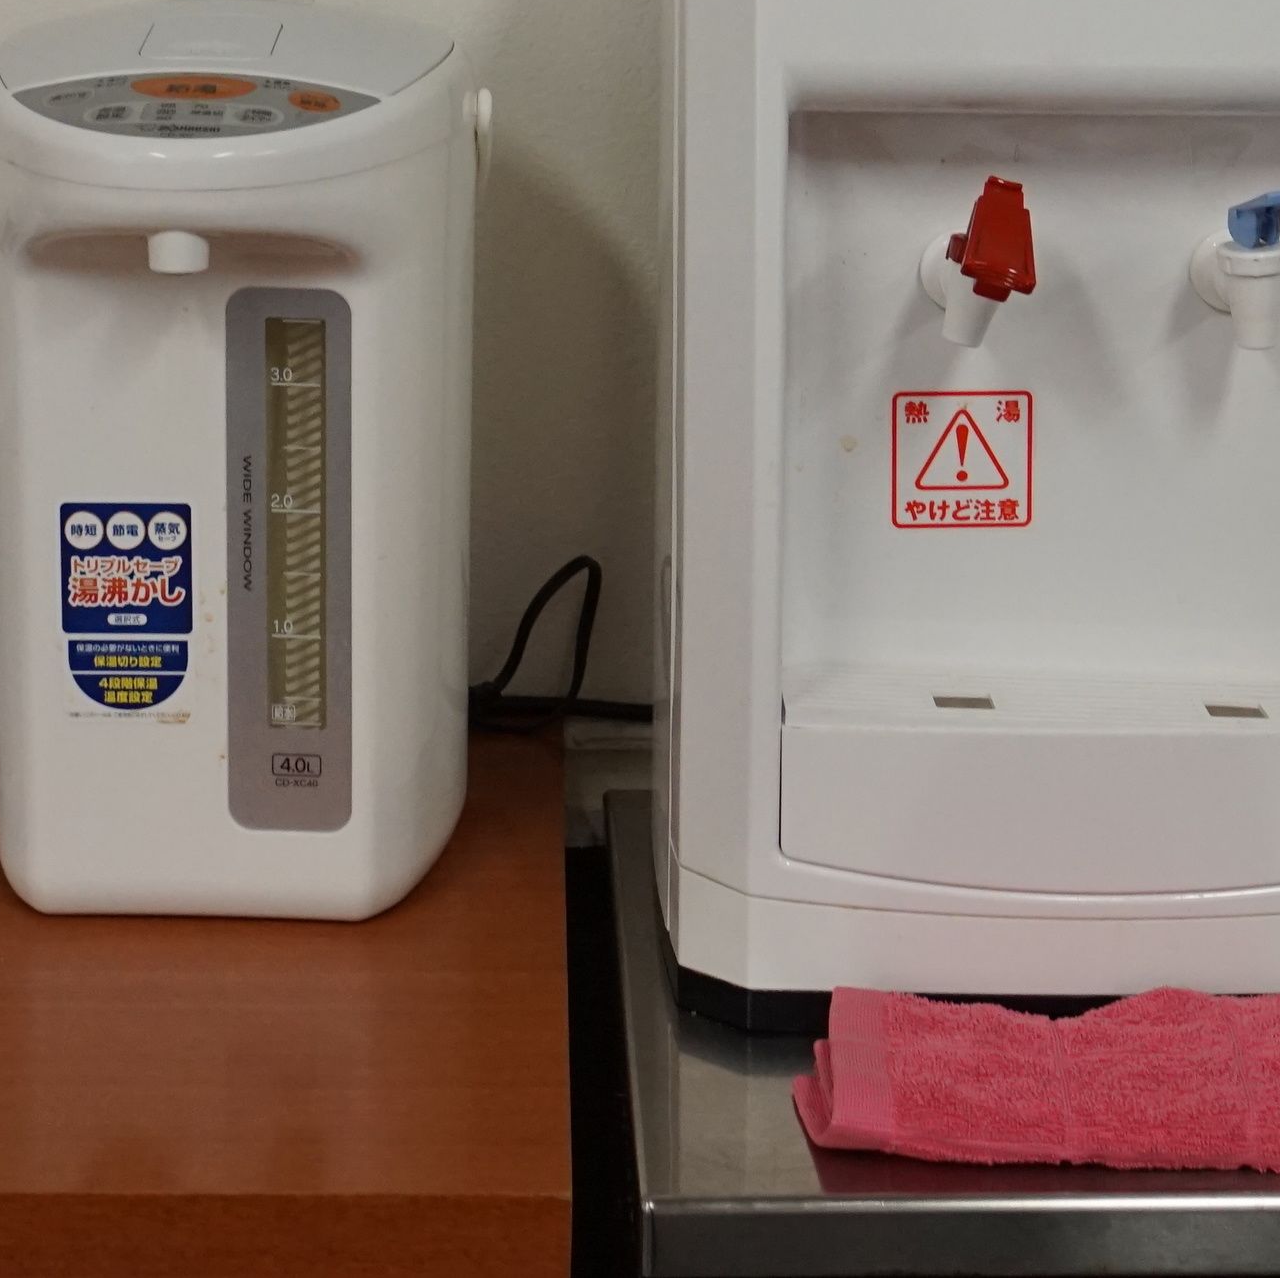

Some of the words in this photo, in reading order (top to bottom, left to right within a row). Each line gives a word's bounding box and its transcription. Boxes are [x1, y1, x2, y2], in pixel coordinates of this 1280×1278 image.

[270, 367, 293, 382] 3.0
[905, 401, 929, 423] 熱
[996, 400, 1020, 422] 湯
[242, 455, 253, 503] WIDE
[270, 494, 293, 508] 2.0
[905, 498, 1019, 521] やけど注意
[70, 524, 97, 537] 時短
[112, 524, 139, 537] 節電
[154, 522, 180, 535] 蒸気
[242, 508, 253, 592] WINDOW
[73, 558, 180, 575] トリプルセーブ
[70, 576, 184, 604] 湯沸かし
[272, 619, 293, 633] 1.0
[280, 758, 314, 773] 4.0L
